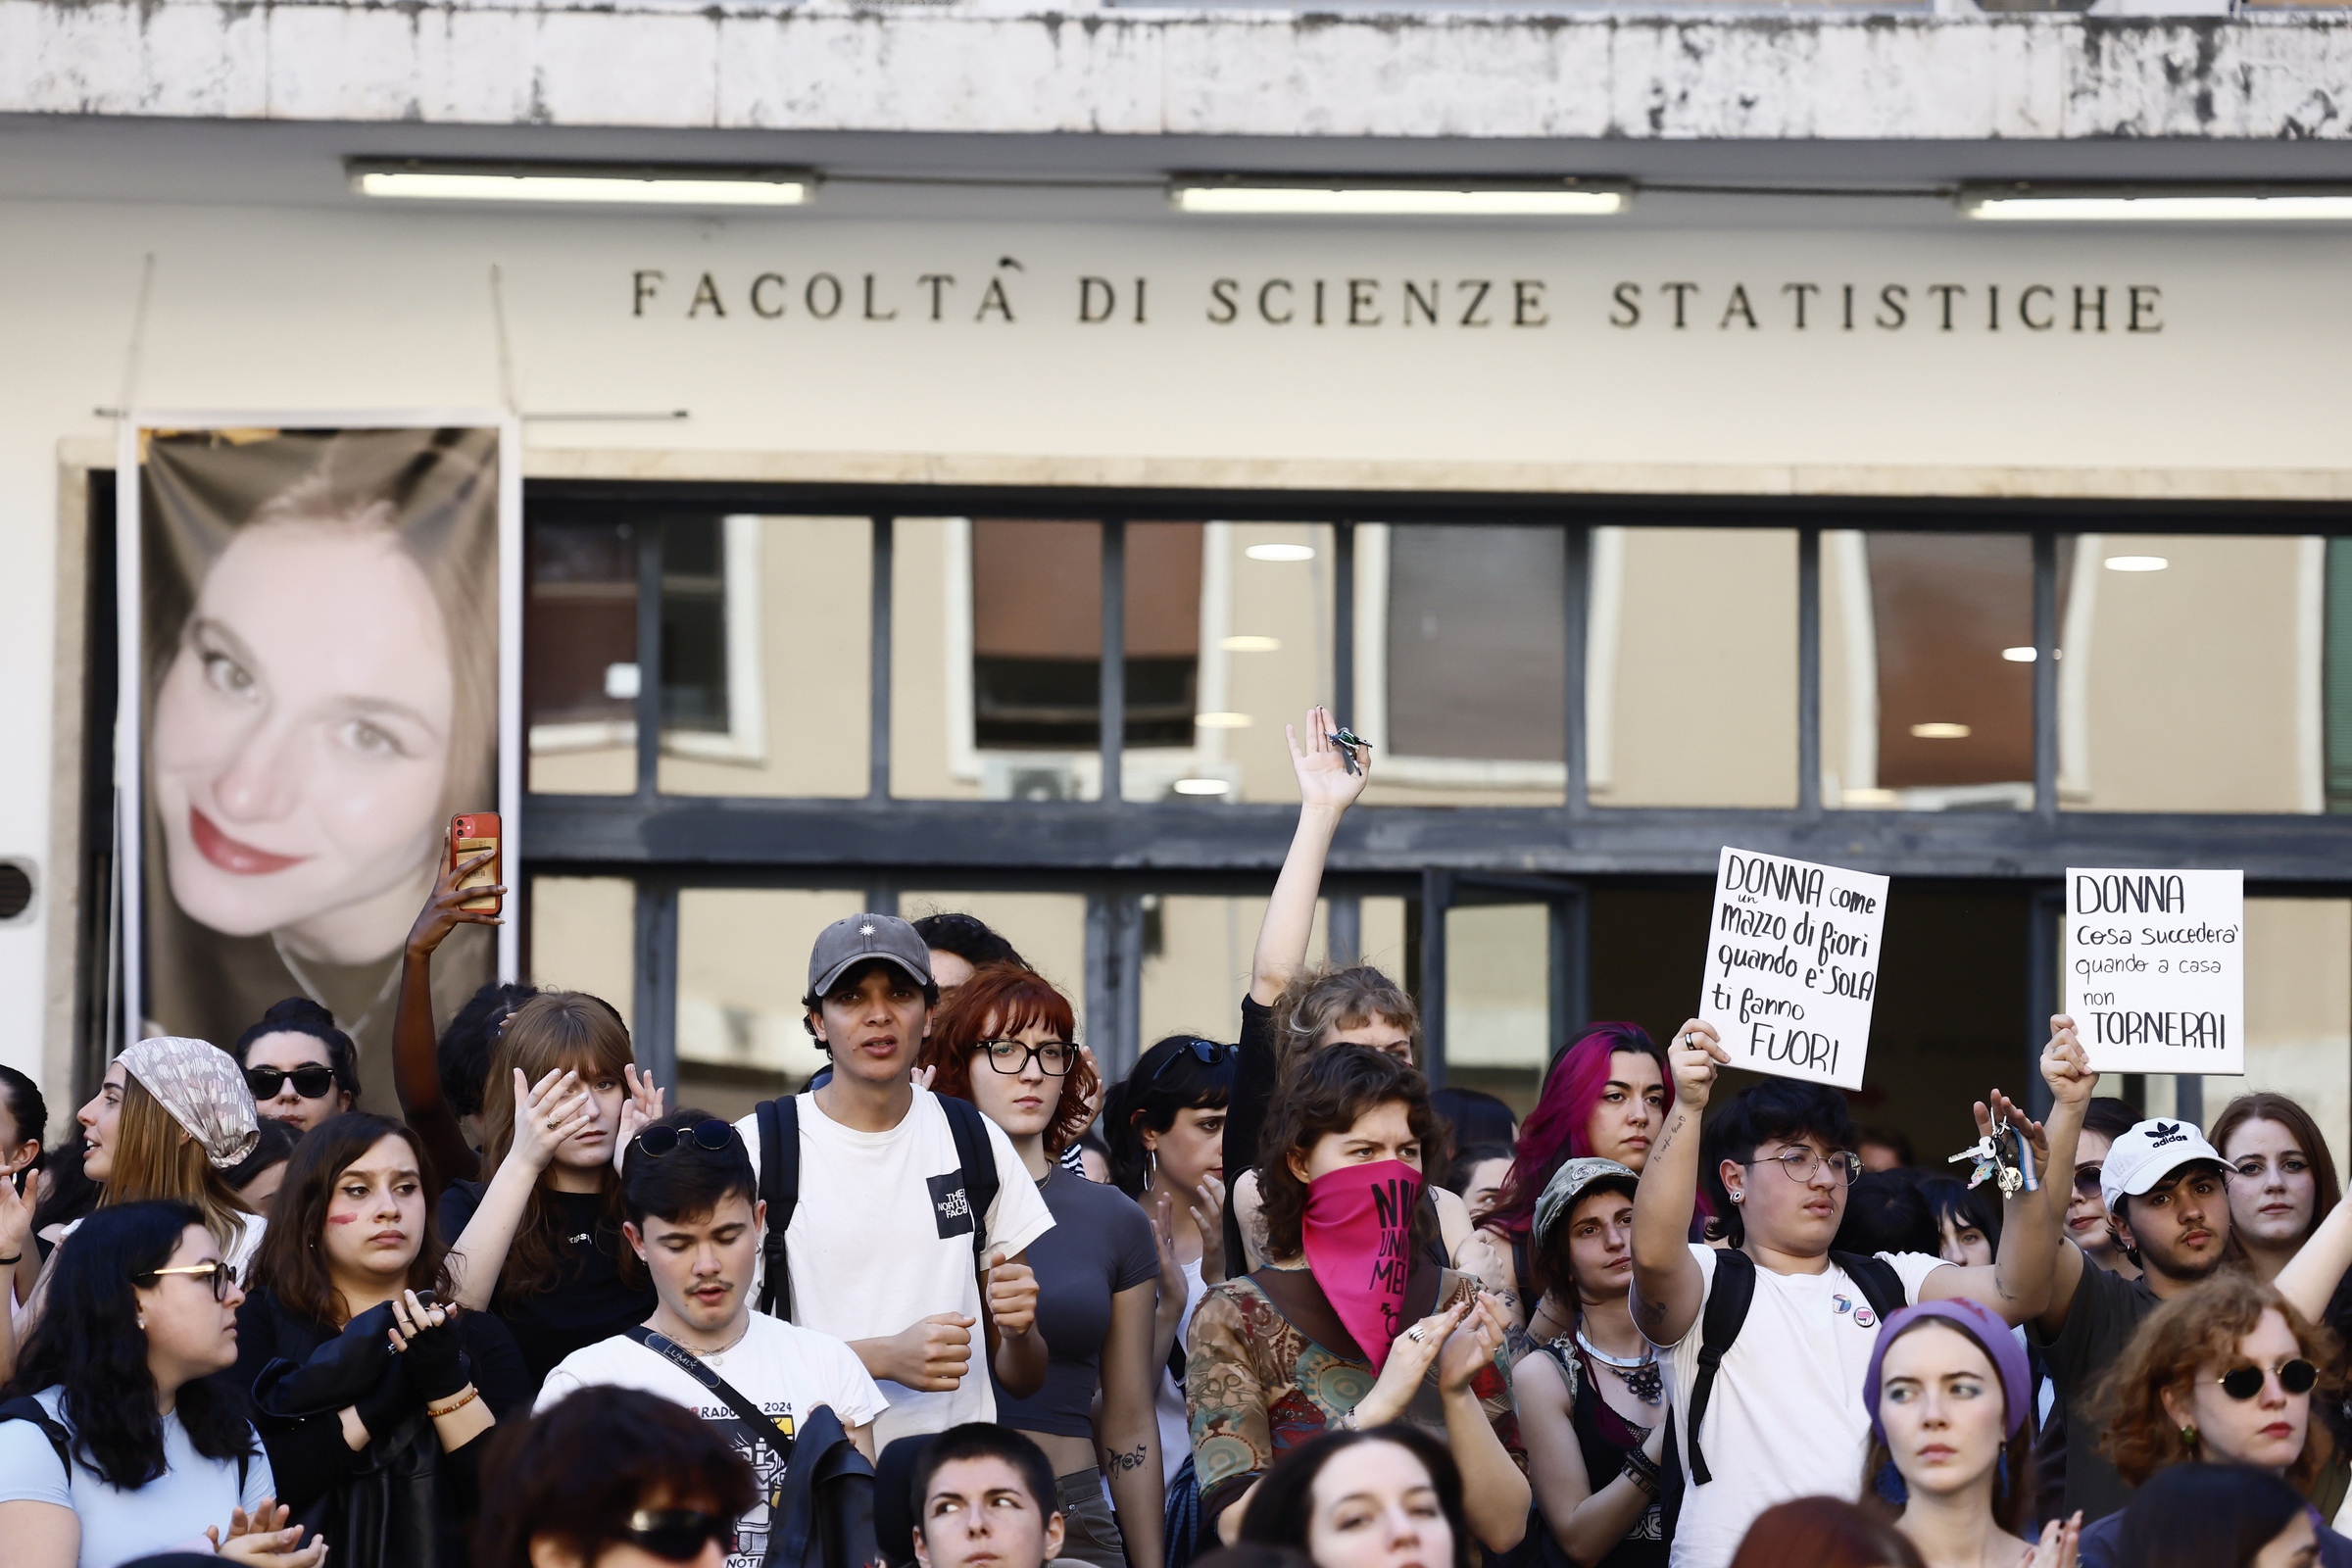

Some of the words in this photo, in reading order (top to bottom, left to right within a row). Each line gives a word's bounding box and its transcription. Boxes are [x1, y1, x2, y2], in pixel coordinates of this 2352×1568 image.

[1078, 276, 1148, 324] DI
[1206, 278, 1550, 327] SCIENZE
[1609, 281, 2166, 334] STATISTICHE
[1725, 855, 1824, 907] DONNA
[2076, 875, 2184, 914] DONNA
[1738, 894, 1759, 905] un
[1793, 911, 1816, 947] di
[1818, 921, 1869, 966] fiori
[1718, 944, 1797, 978] quando
[1823, 965, 1875, 1002] SOLA
[2075, 954, 2149, 986] quando
[2158, 959, 2169, 973] a
[2179, 959, 2222, 974] casa
[1712, 983, 1732, 1010] ti
[1740, 987, 1805, 1024] fanno
[2083, 992, 2115, 1006] non
[2089, 1011, 2226, 1051] TORNERAI
[1750, 1022, 1839, 1076] FUORI
[2152, 1135, 2188, 1149] adidas
[937, 1197, 967, 1211] NORTH
[946, 1189, 965, 1202] THE
[946, 1206, 968, 1219] FACE
[664, 1344, 697, 1369] LUMIX
[764, 1402, 792, 1412] 2024
